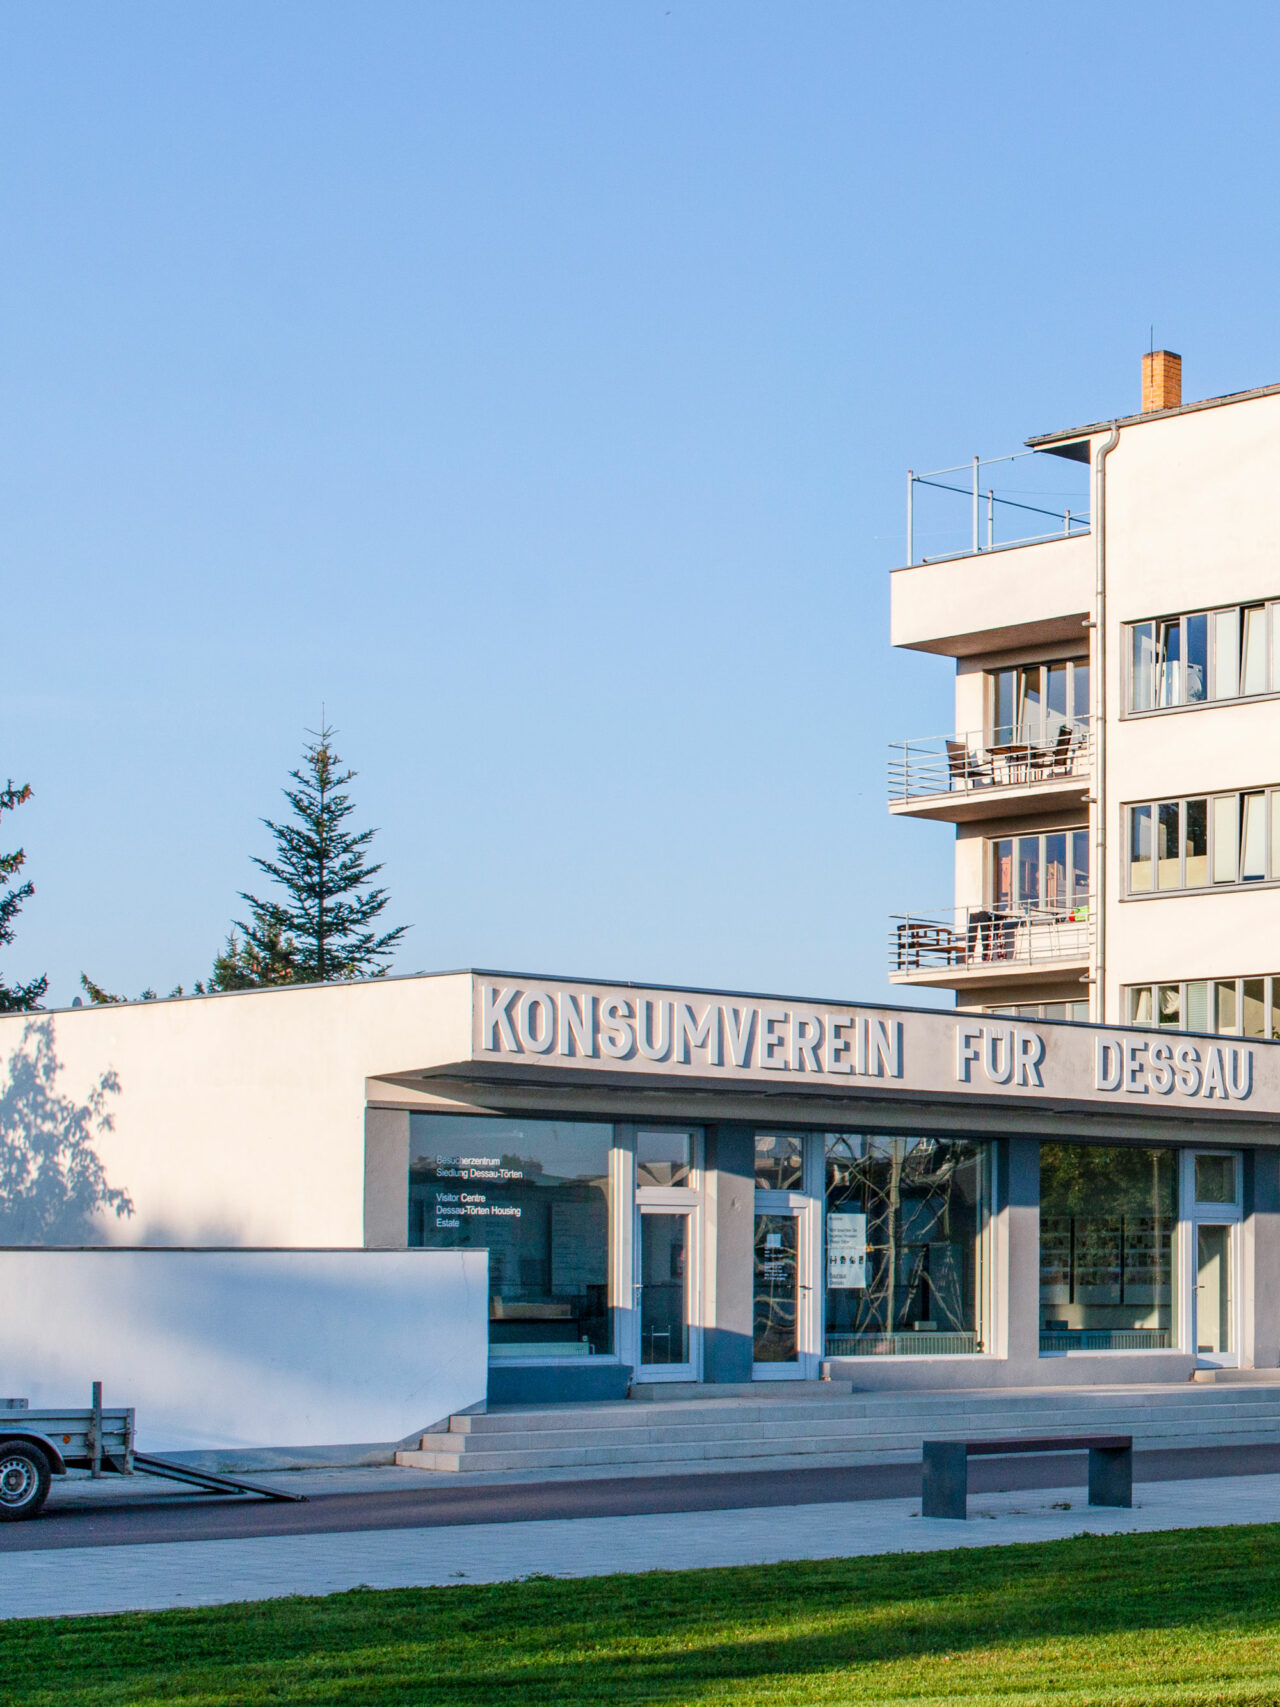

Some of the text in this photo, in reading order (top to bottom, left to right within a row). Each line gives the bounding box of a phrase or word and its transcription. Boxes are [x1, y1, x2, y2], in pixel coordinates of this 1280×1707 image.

[481, 985, 902, 1078] KONSUMVEREIN
[1095, 1036, 1252, 1100] DESSAU
[436, 1155, 500, 1166] Besucherzentrum
[436, 1168, 523, 1179] Siedlung Dessau-Törten
[436, 1192, 486, 1203] Visitor Centre
[436, 1205, 521, 1217] Dessau-Törten Housing
[436, 1218, 460, 1228] Estate
